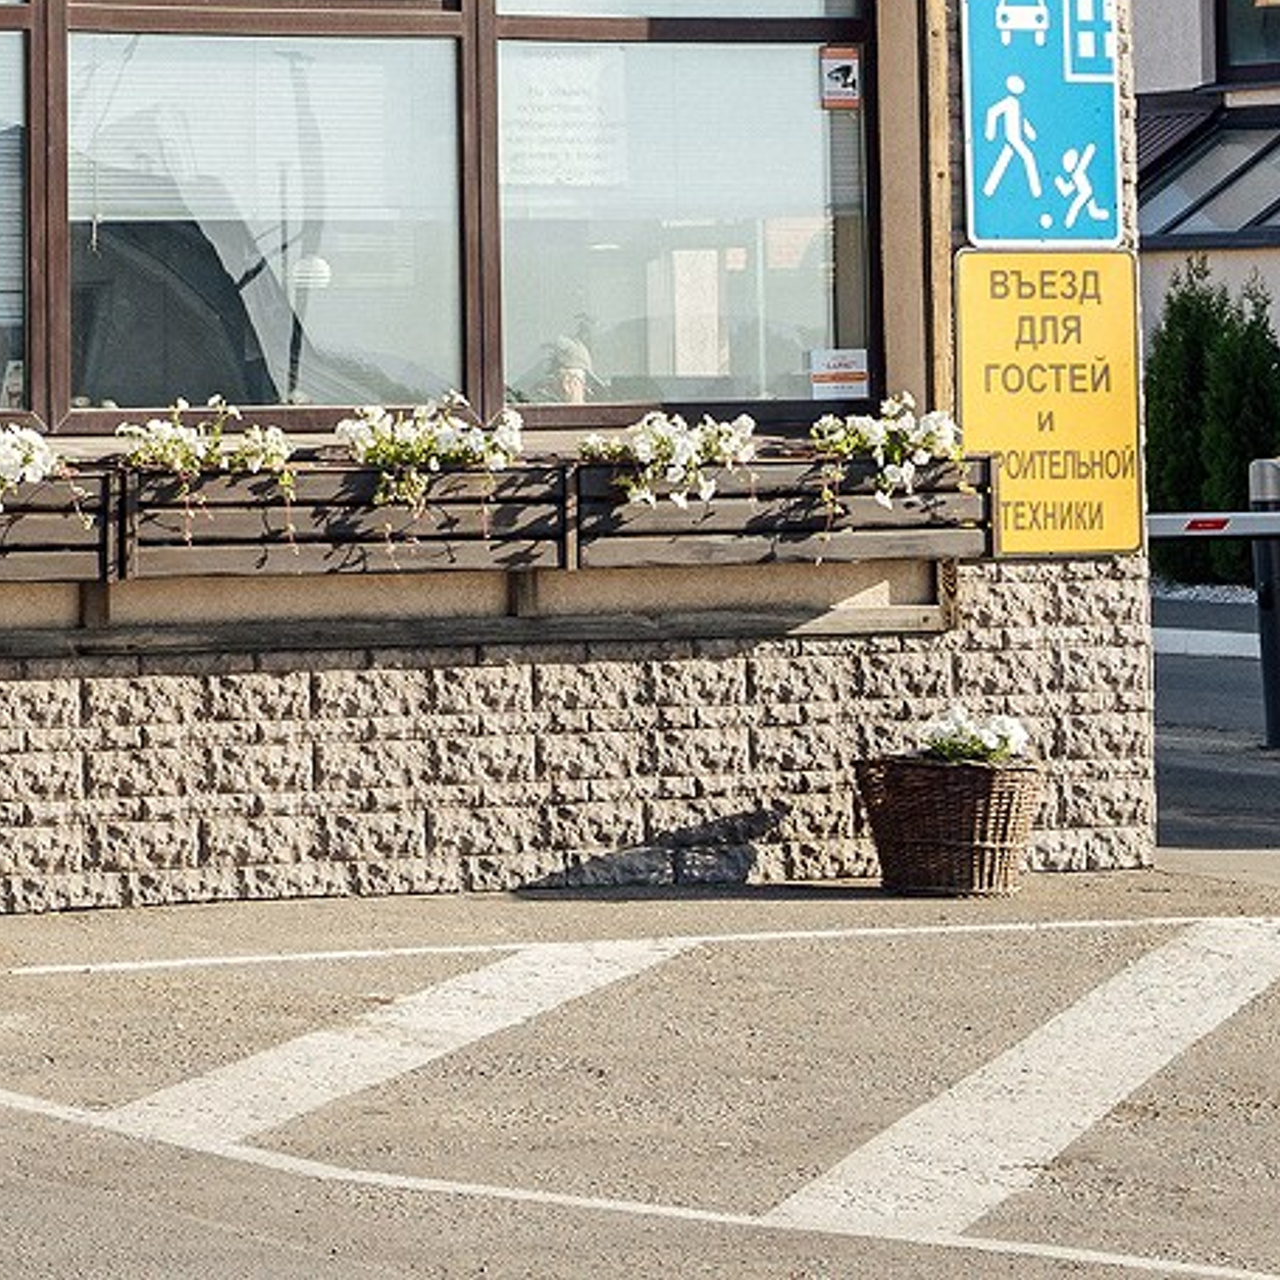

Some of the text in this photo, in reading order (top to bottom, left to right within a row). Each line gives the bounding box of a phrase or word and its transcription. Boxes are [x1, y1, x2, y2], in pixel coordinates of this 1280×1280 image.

[989, 269, 1102, 305] ВЪЕЗД
[1014, 314, 1082, 351] ДЛЯ
[984, 356, 1111, 393] ГОСТЕЙ
[1001, 500, 1104, 531] ТЕХНИКИ
